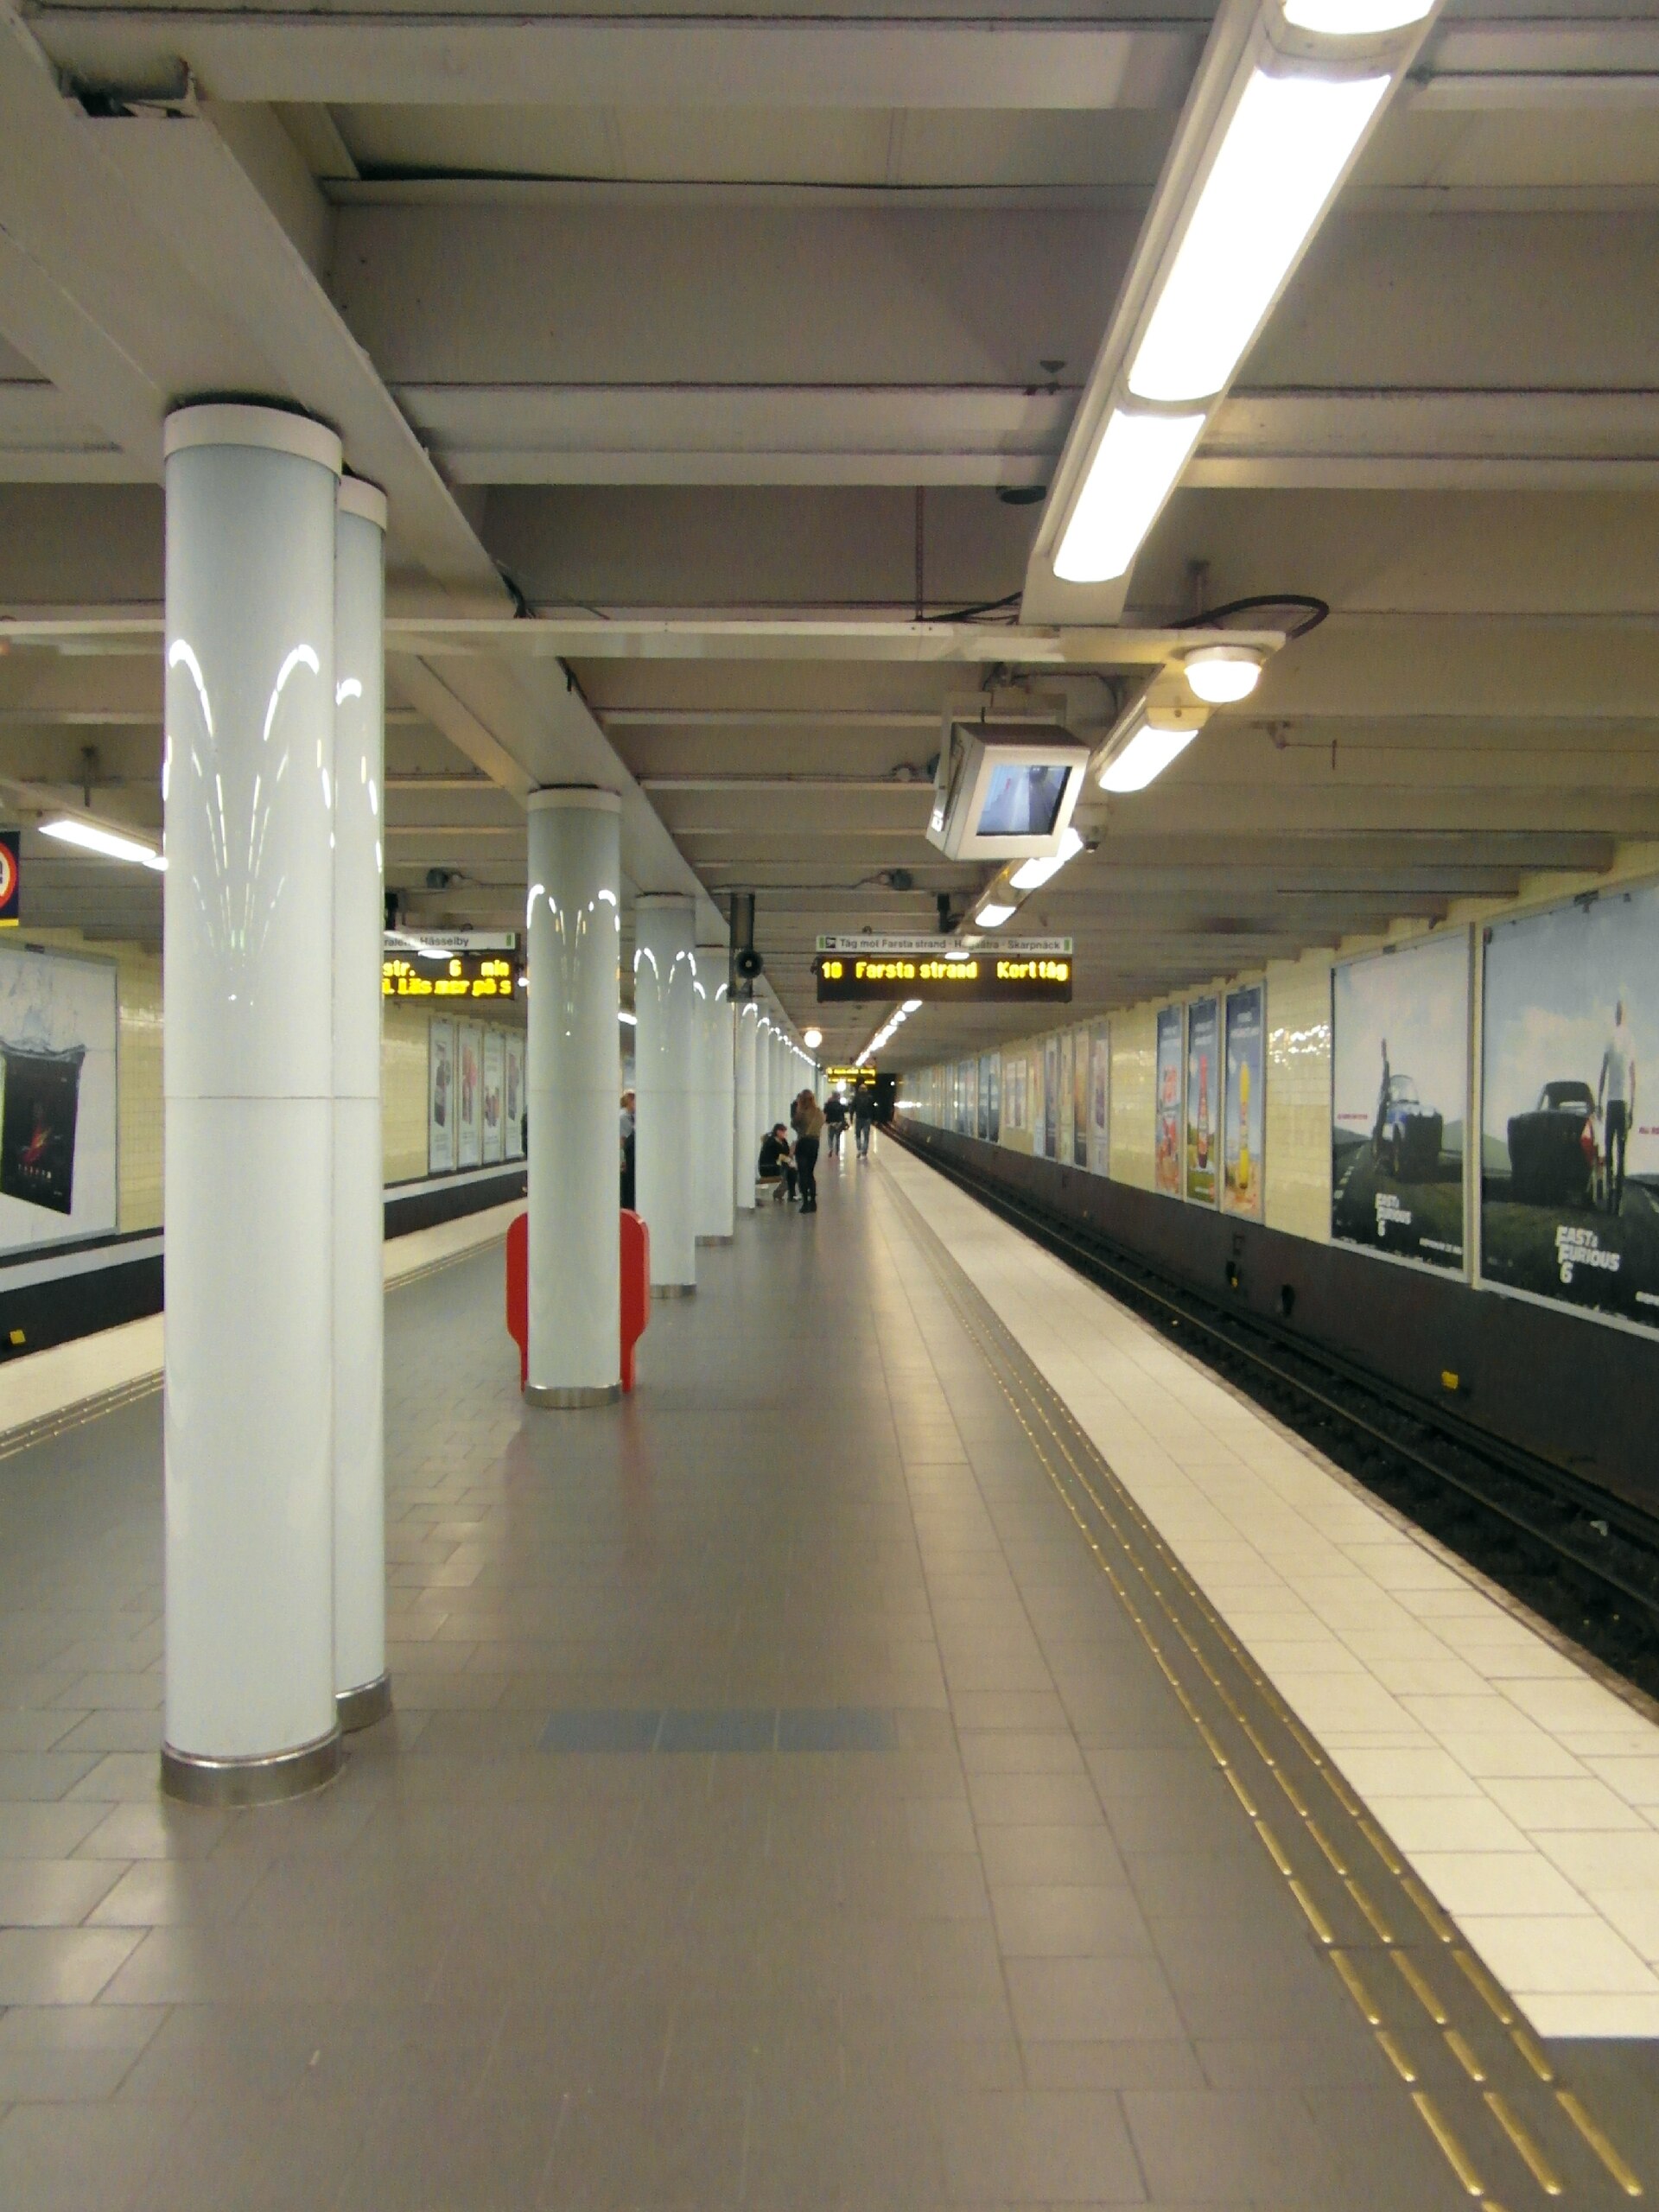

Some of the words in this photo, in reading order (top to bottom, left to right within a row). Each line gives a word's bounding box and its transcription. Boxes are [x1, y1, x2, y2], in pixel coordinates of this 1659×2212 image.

[840, 938, 858, 949] Tåg
[861, 939, 880, 948] mot
[881, 939, 913, 948] Farsta
[916, 938, 947, 949] strand
[1007, 938, 1060, 950] Skarpnäck
[449, 959, 461, 976] 6
[822, 962, 842, 979] 10
[855, 962, 915, 979] Farsta
[919, 961, 977, 979] strand
[1557, 1243, 1621, 1272] FURIOUS
[1560, 1262, 1574, 1284] 6
